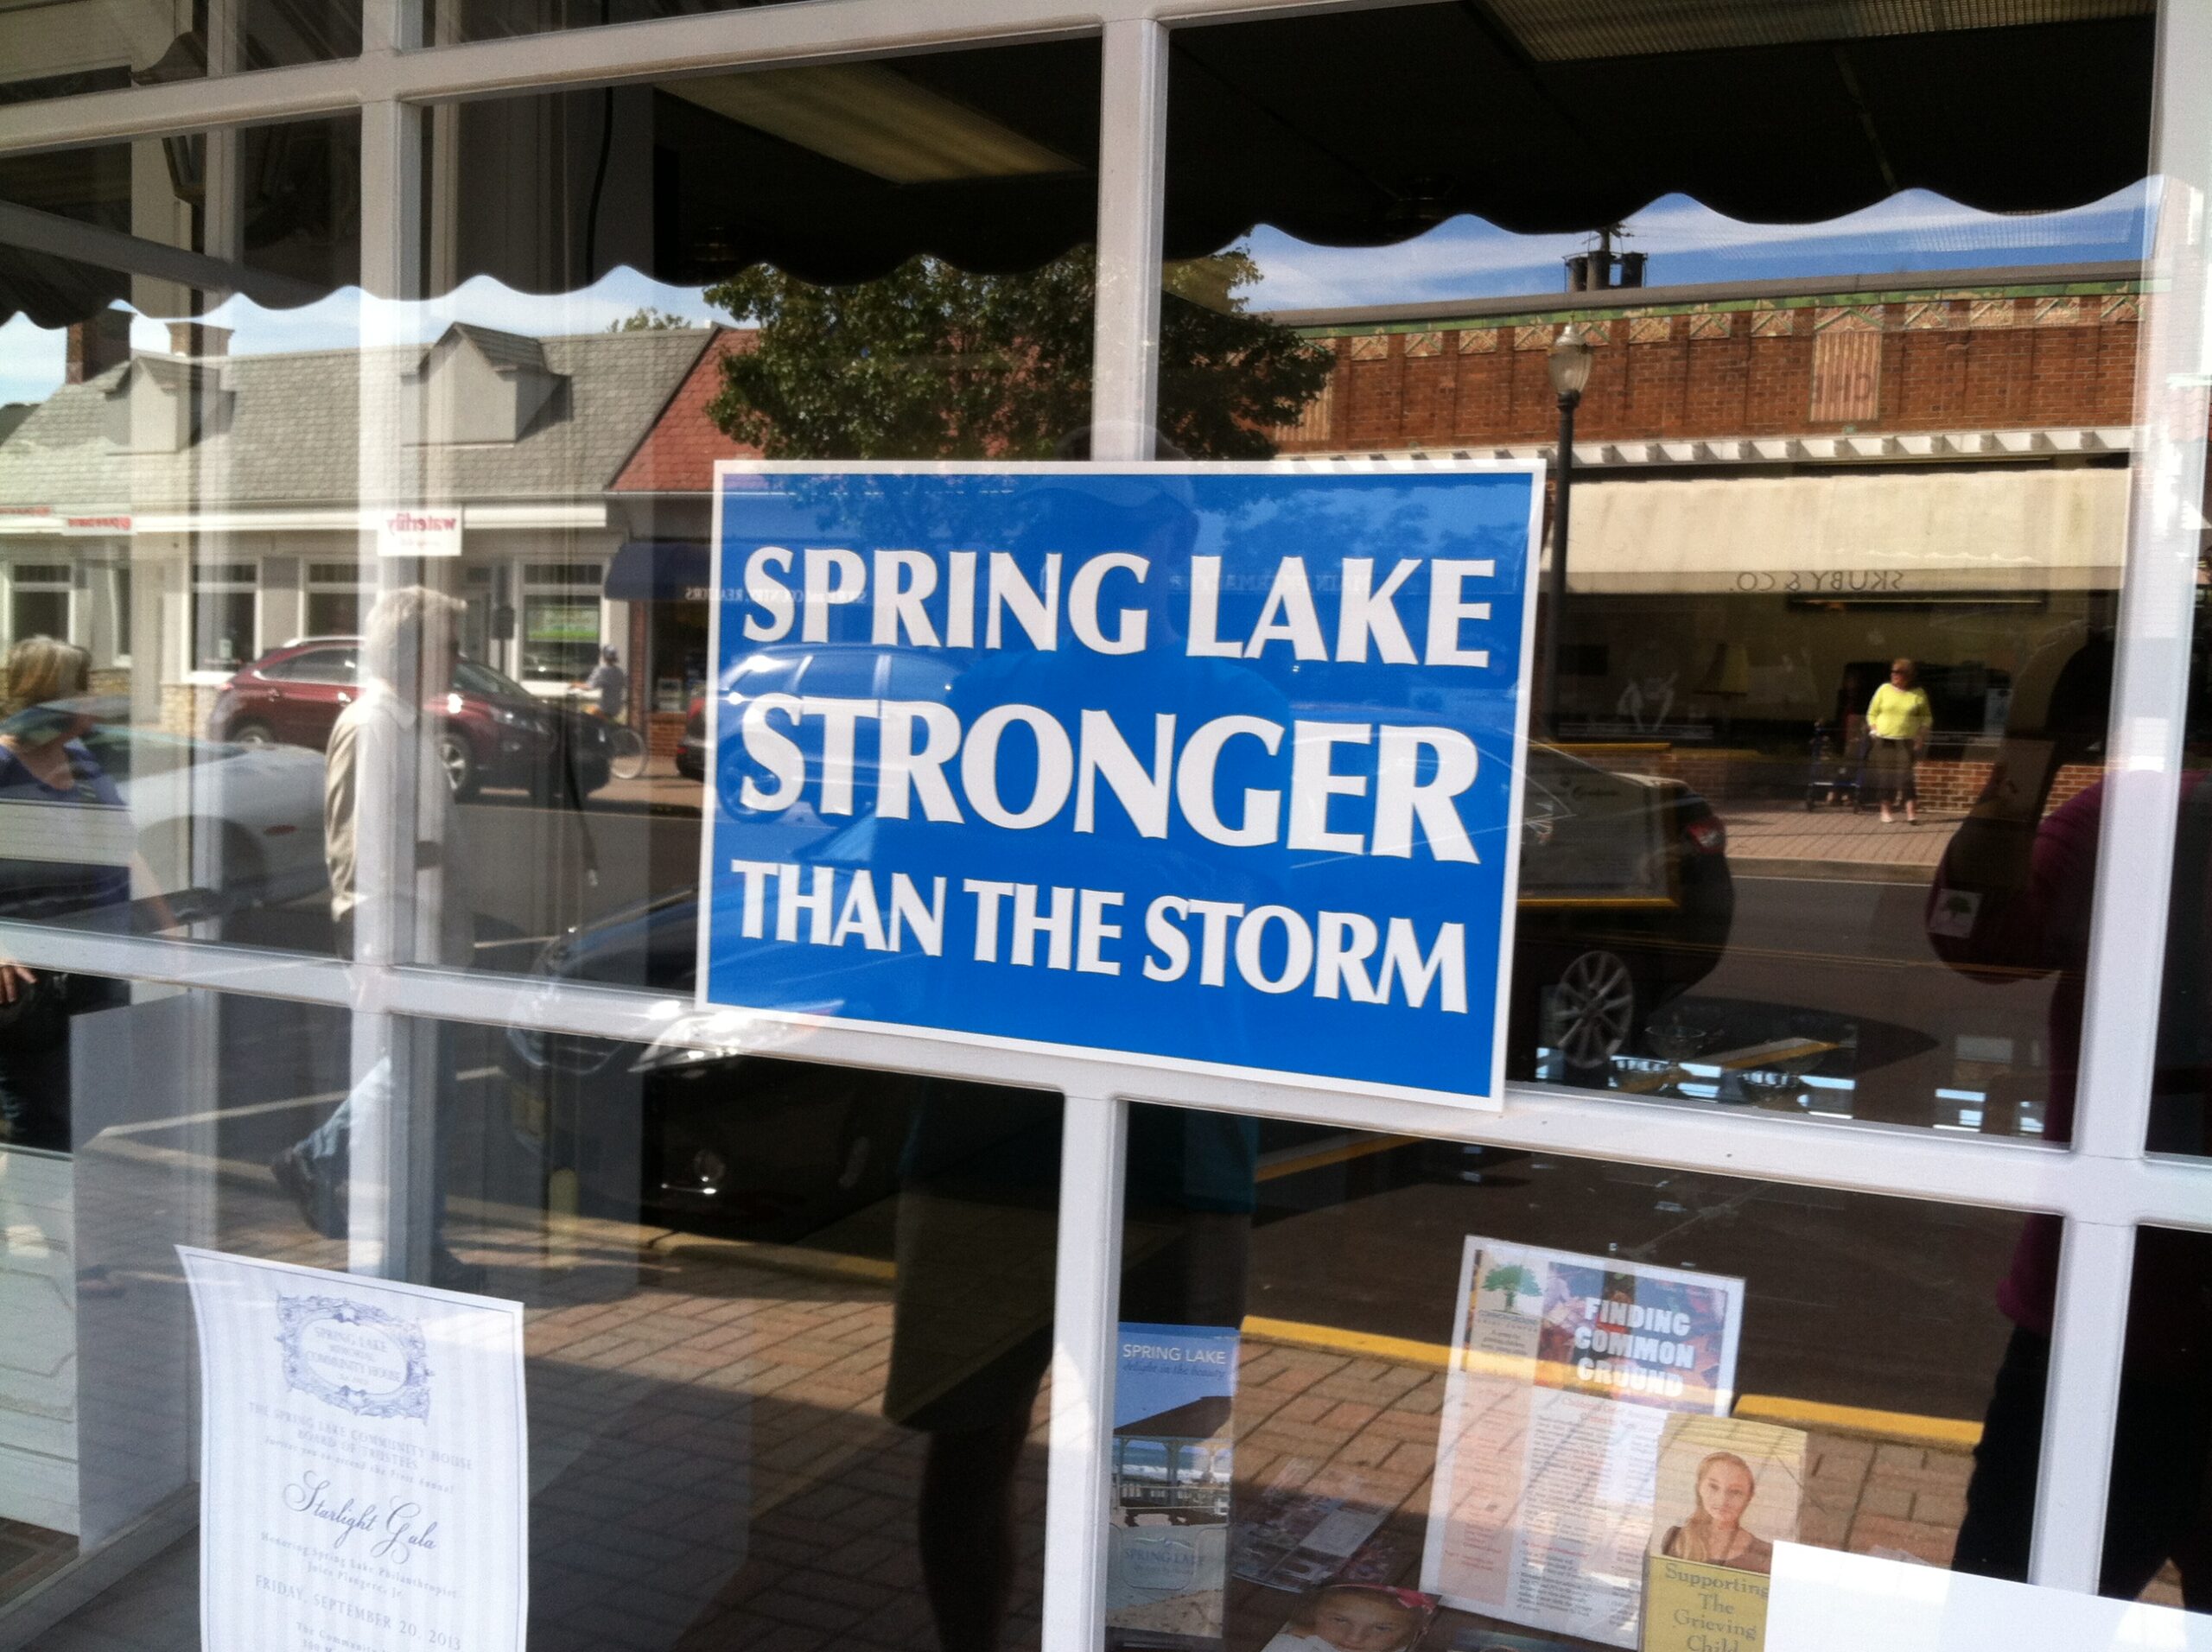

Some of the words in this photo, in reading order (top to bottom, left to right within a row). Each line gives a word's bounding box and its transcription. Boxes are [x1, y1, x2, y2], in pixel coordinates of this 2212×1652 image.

[742, 546, 1151, 656] SPRING
[1185, 555, 1497, 668] LAKE
[739, 692, 1481, 864] STRONGER
[730, 858, 947, 957] THAN
[963, 878, 1125, 977] THE
[1141, 893, 1469, 1015] STORM
[1585, 1296, 1691, 1337] FINDING
[1122, 1344, 1181, 1361] SPRING
[1185, 1349, 1226, 1364] LAKE
[1574, 1325, 1695, 1369] COMMON
[1576, 1357, 1684, 1397] GROUND
[282, 1470, 378, 1549] Starlight
[370, 1495, 438, 1565] Gala
[1664, 1562, 1769, 1598] Supporting
[314, 1592, 392, 1630] SEPTEMBER
[429, 1629, 462, 1652] 2013
[1697, 1592, 1736, 1615] The
[1673, 1608, 1758, 1642] Grieving
[1686, 1634, 1739, 1652] Child
